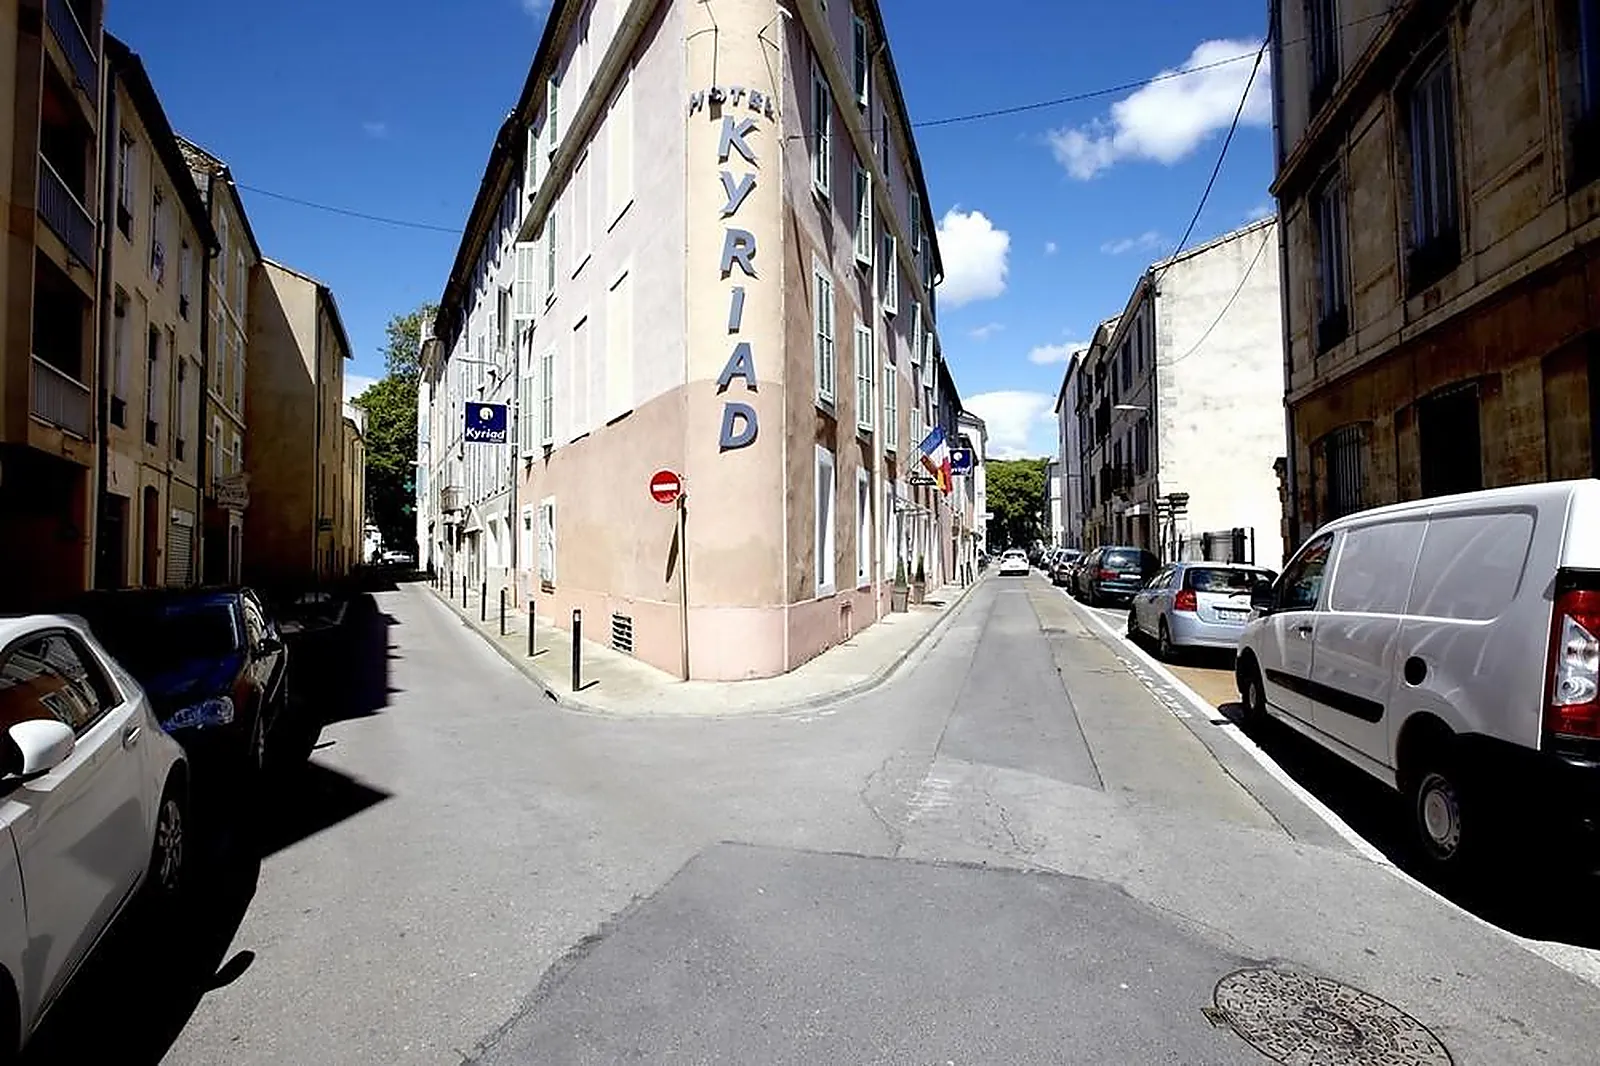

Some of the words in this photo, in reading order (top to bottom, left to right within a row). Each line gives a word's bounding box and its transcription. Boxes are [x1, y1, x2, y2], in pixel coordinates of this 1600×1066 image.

[689, 88, 775, 122] HOTEL
[717, 116, 760, 453] KYRIAD
[466, 427, 505, 439] Kyriad
